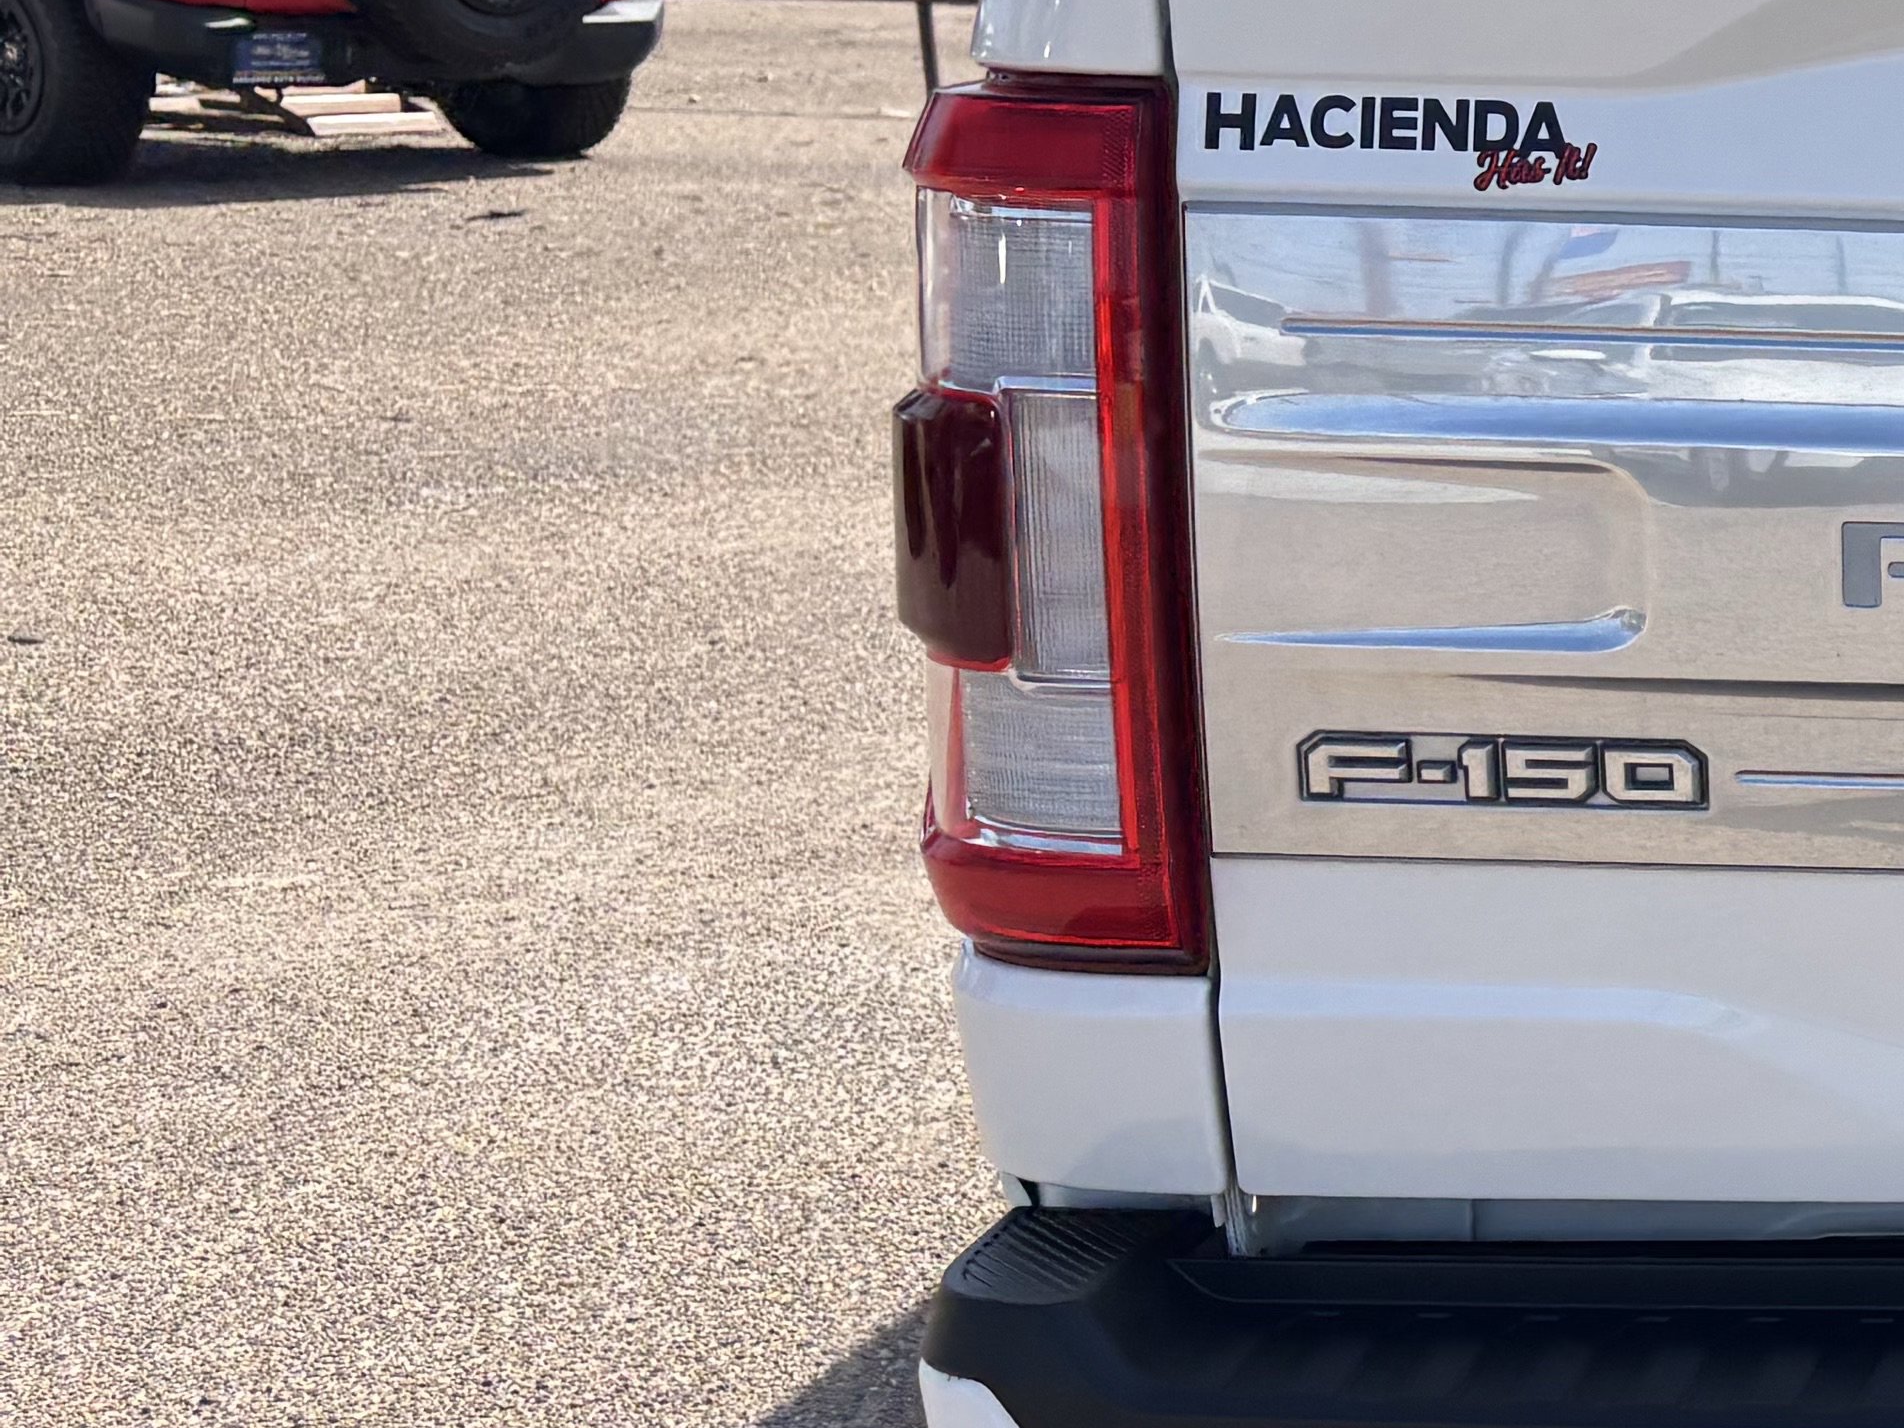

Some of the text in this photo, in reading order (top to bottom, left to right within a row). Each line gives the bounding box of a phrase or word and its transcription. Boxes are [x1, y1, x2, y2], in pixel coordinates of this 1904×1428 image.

[1204, 91, 1567, 159] HACIENDA
[1473, 148, 1551, 192] Has
[1297, 730, 1709, 811] F-150
